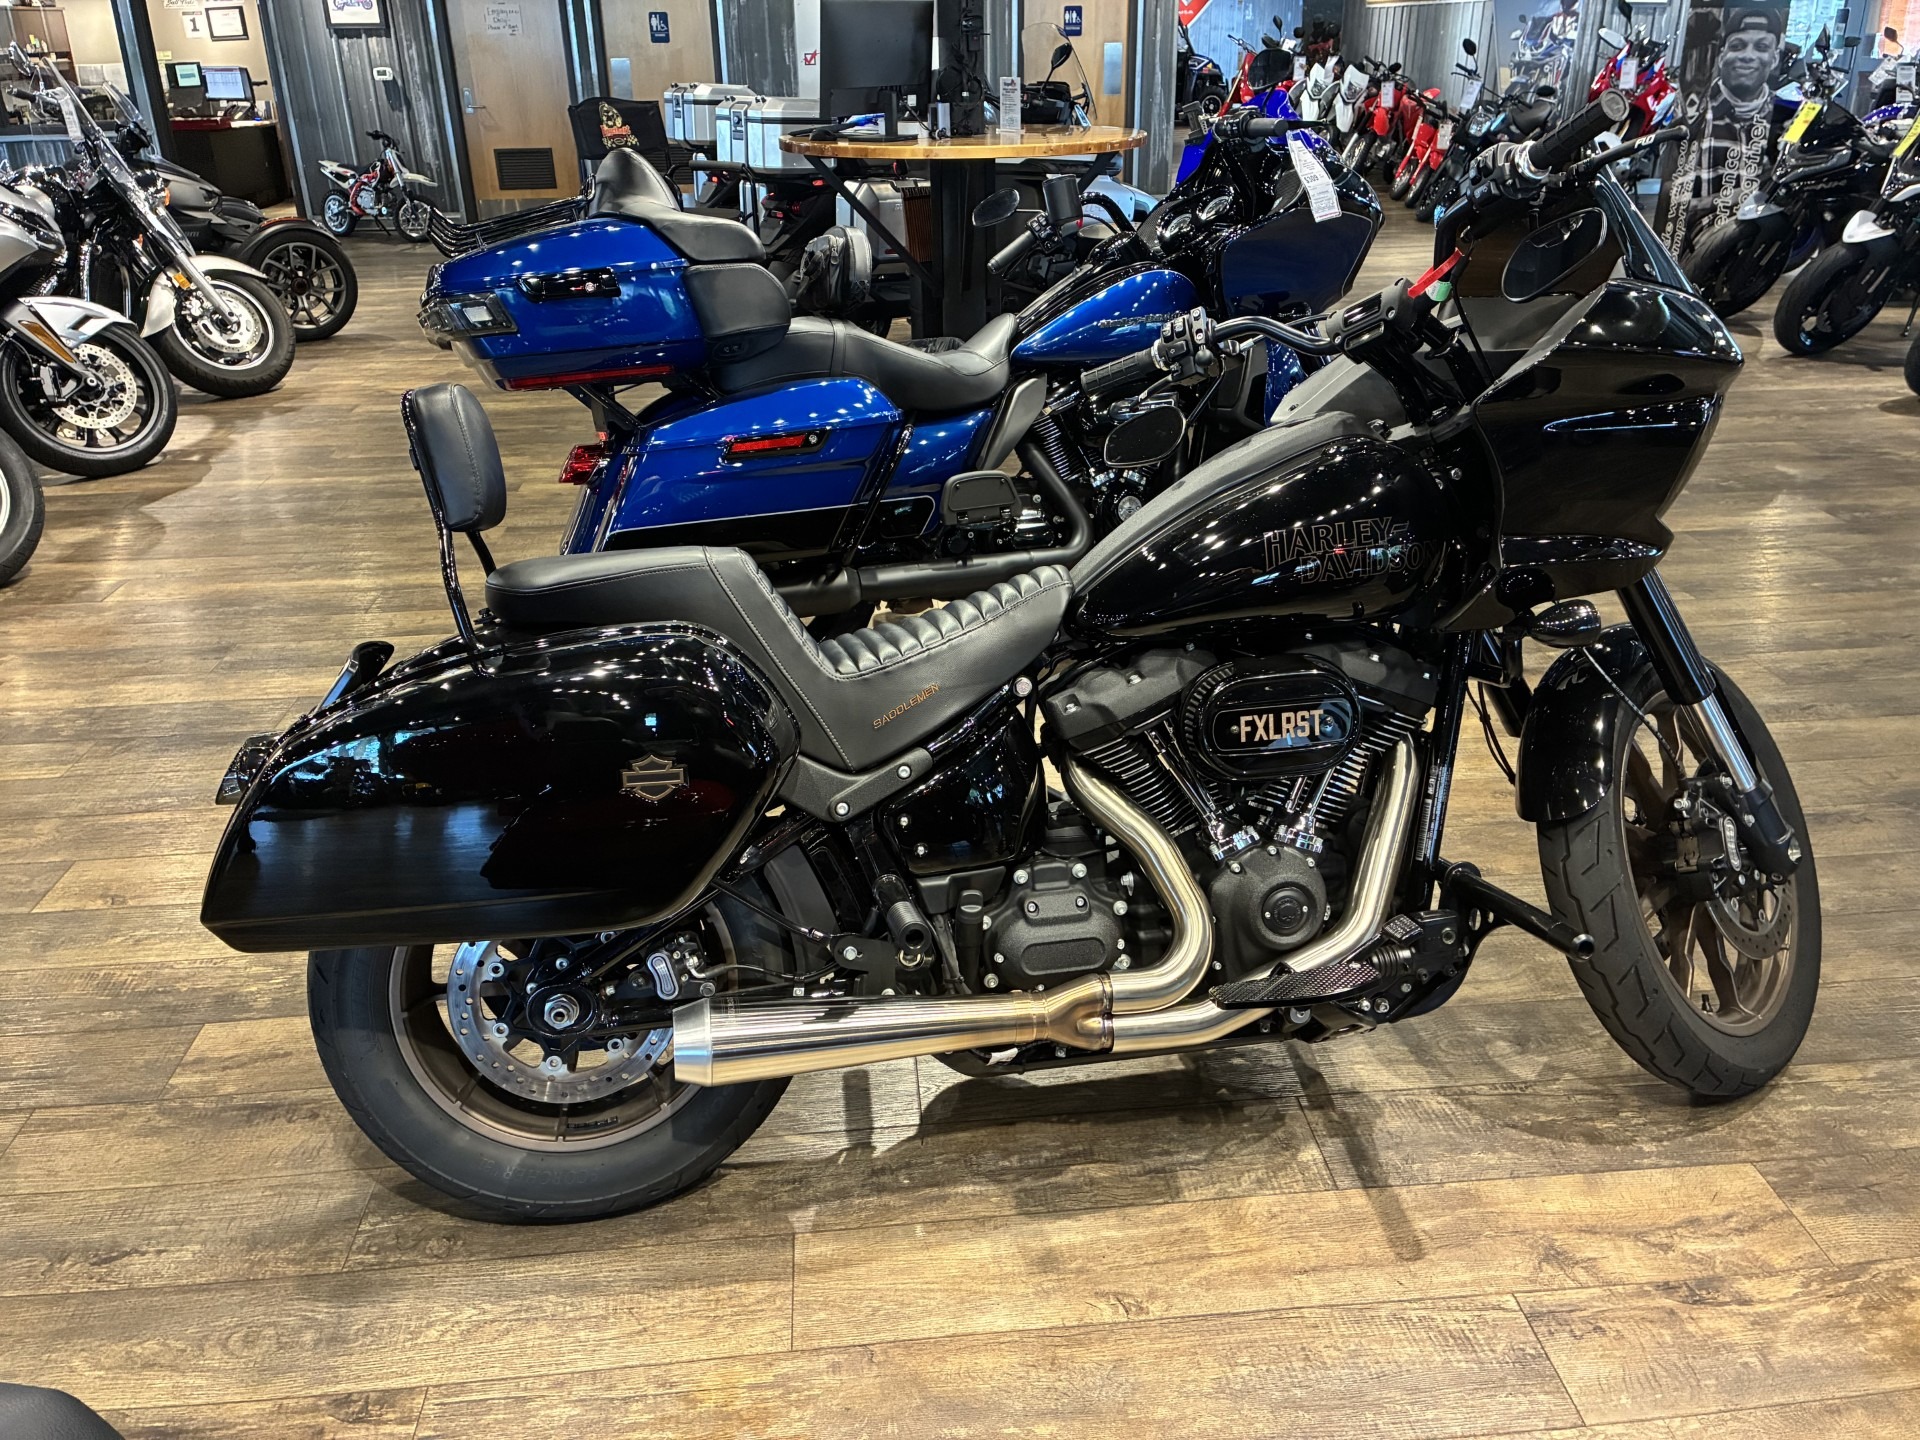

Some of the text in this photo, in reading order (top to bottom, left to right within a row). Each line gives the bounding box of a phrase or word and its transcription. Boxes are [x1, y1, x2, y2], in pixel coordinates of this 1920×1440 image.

[189, 17, 200, 32] 1
[1668, 139, 1689, 219] withou
[1672, 140, 1698, 262] ompromise
[1300, 540, 1437, 585] DAVIDSON
[873, 682, 940, 729] SADDLEMEN
[1239, 709, 1324, 743] FXLRST
